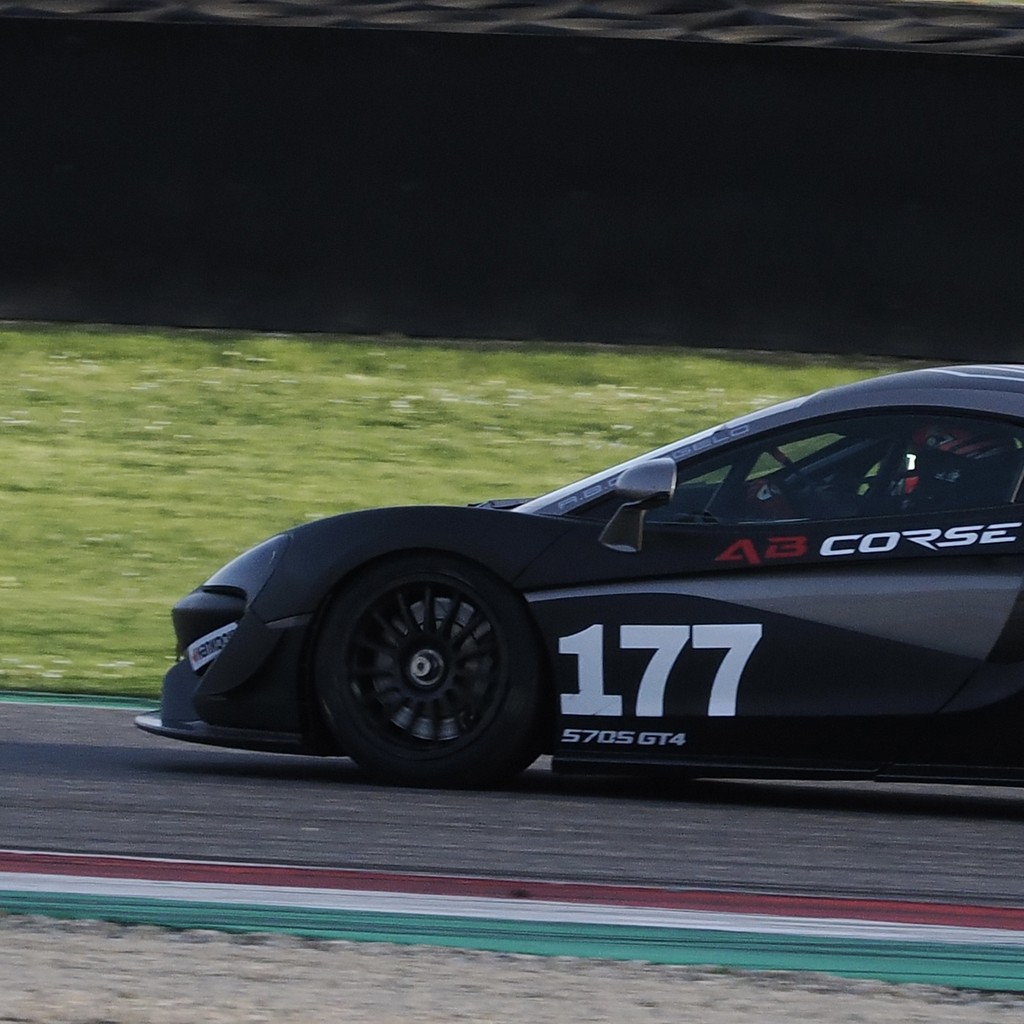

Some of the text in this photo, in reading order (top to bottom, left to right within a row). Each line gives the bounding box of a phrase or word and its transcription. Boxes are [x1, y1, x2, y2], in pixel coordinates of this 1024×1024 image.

[714, 522, 1023, 564] AB CORSE
[558, 624, 763, 717] 177
[560, 728, 687, 746] 570S GT4
